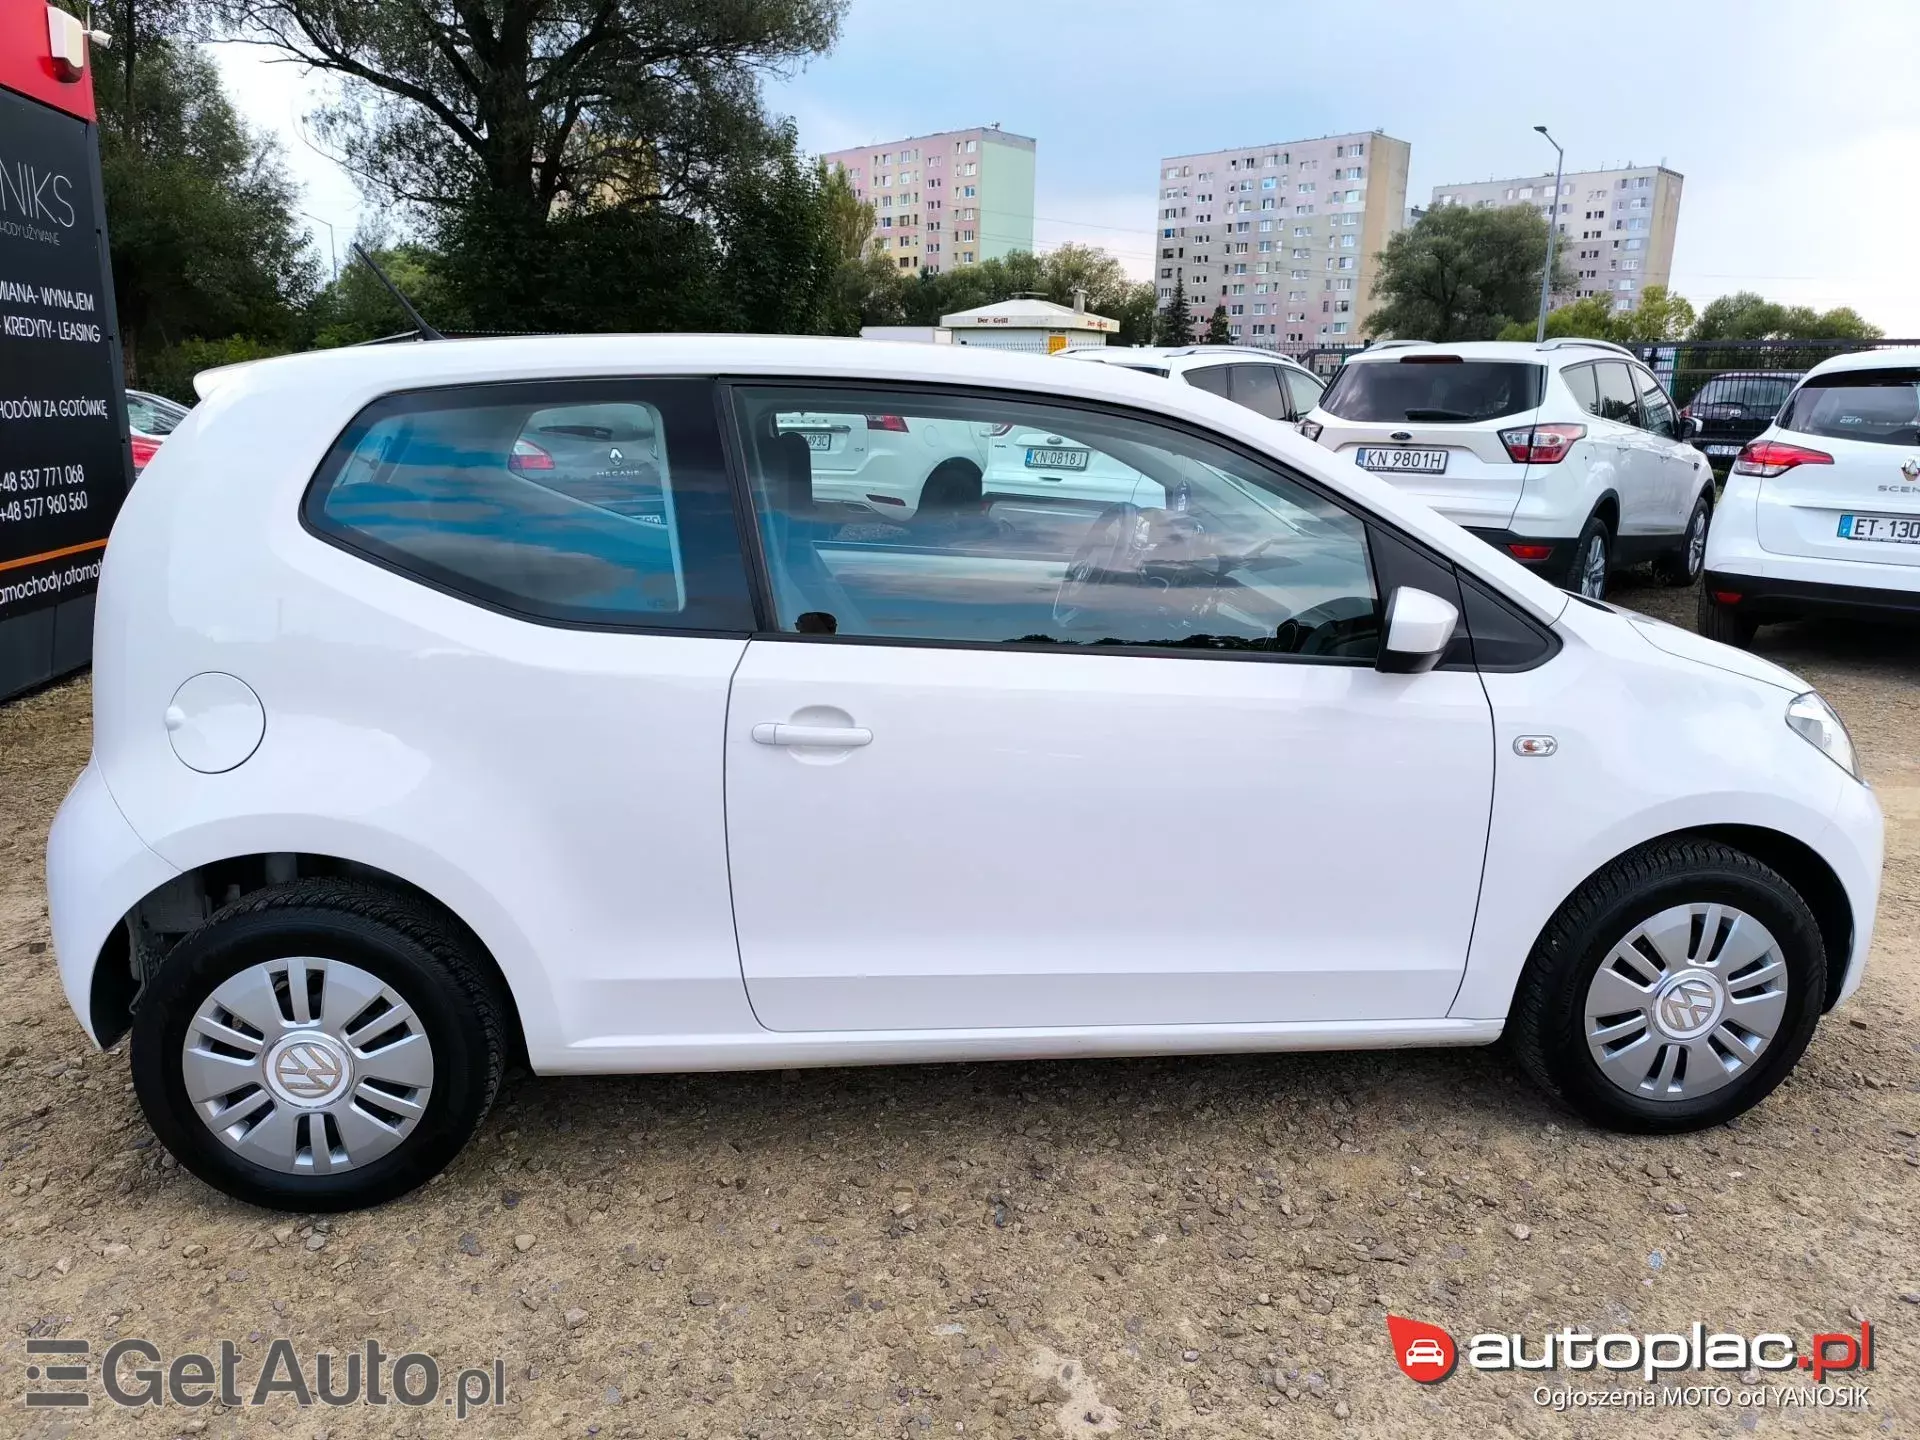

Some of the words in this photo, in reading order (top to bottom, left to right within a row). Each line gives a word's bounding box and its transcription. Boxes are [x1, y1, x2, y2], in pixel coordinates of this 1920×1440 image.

[0, 158, 75, 228] NIKS
[40, 286, 95, 312] WYNAJEM
[58, 321, 101, 343] LEASING
[43, 399, 59, 418] ZA
[59, 395, 108, 420] GOTÓWKĘ
[1033, 451, 1048, 463] KN
[1050, 452, 1083, 466] 0818J
[1366, 450, 1388, 466] KN
[1392, 451, 1442, 468] 9801H
[20, 469, 40, 490] 537
[43, 467, 62, 487] 771
[64, 464, 85, 484] 068
[0, 501, 21, 522] +48
[24, 497, 43, 519] 577
[46, 493, 67, 515] 960
[69, 490, 88, 511] 560
